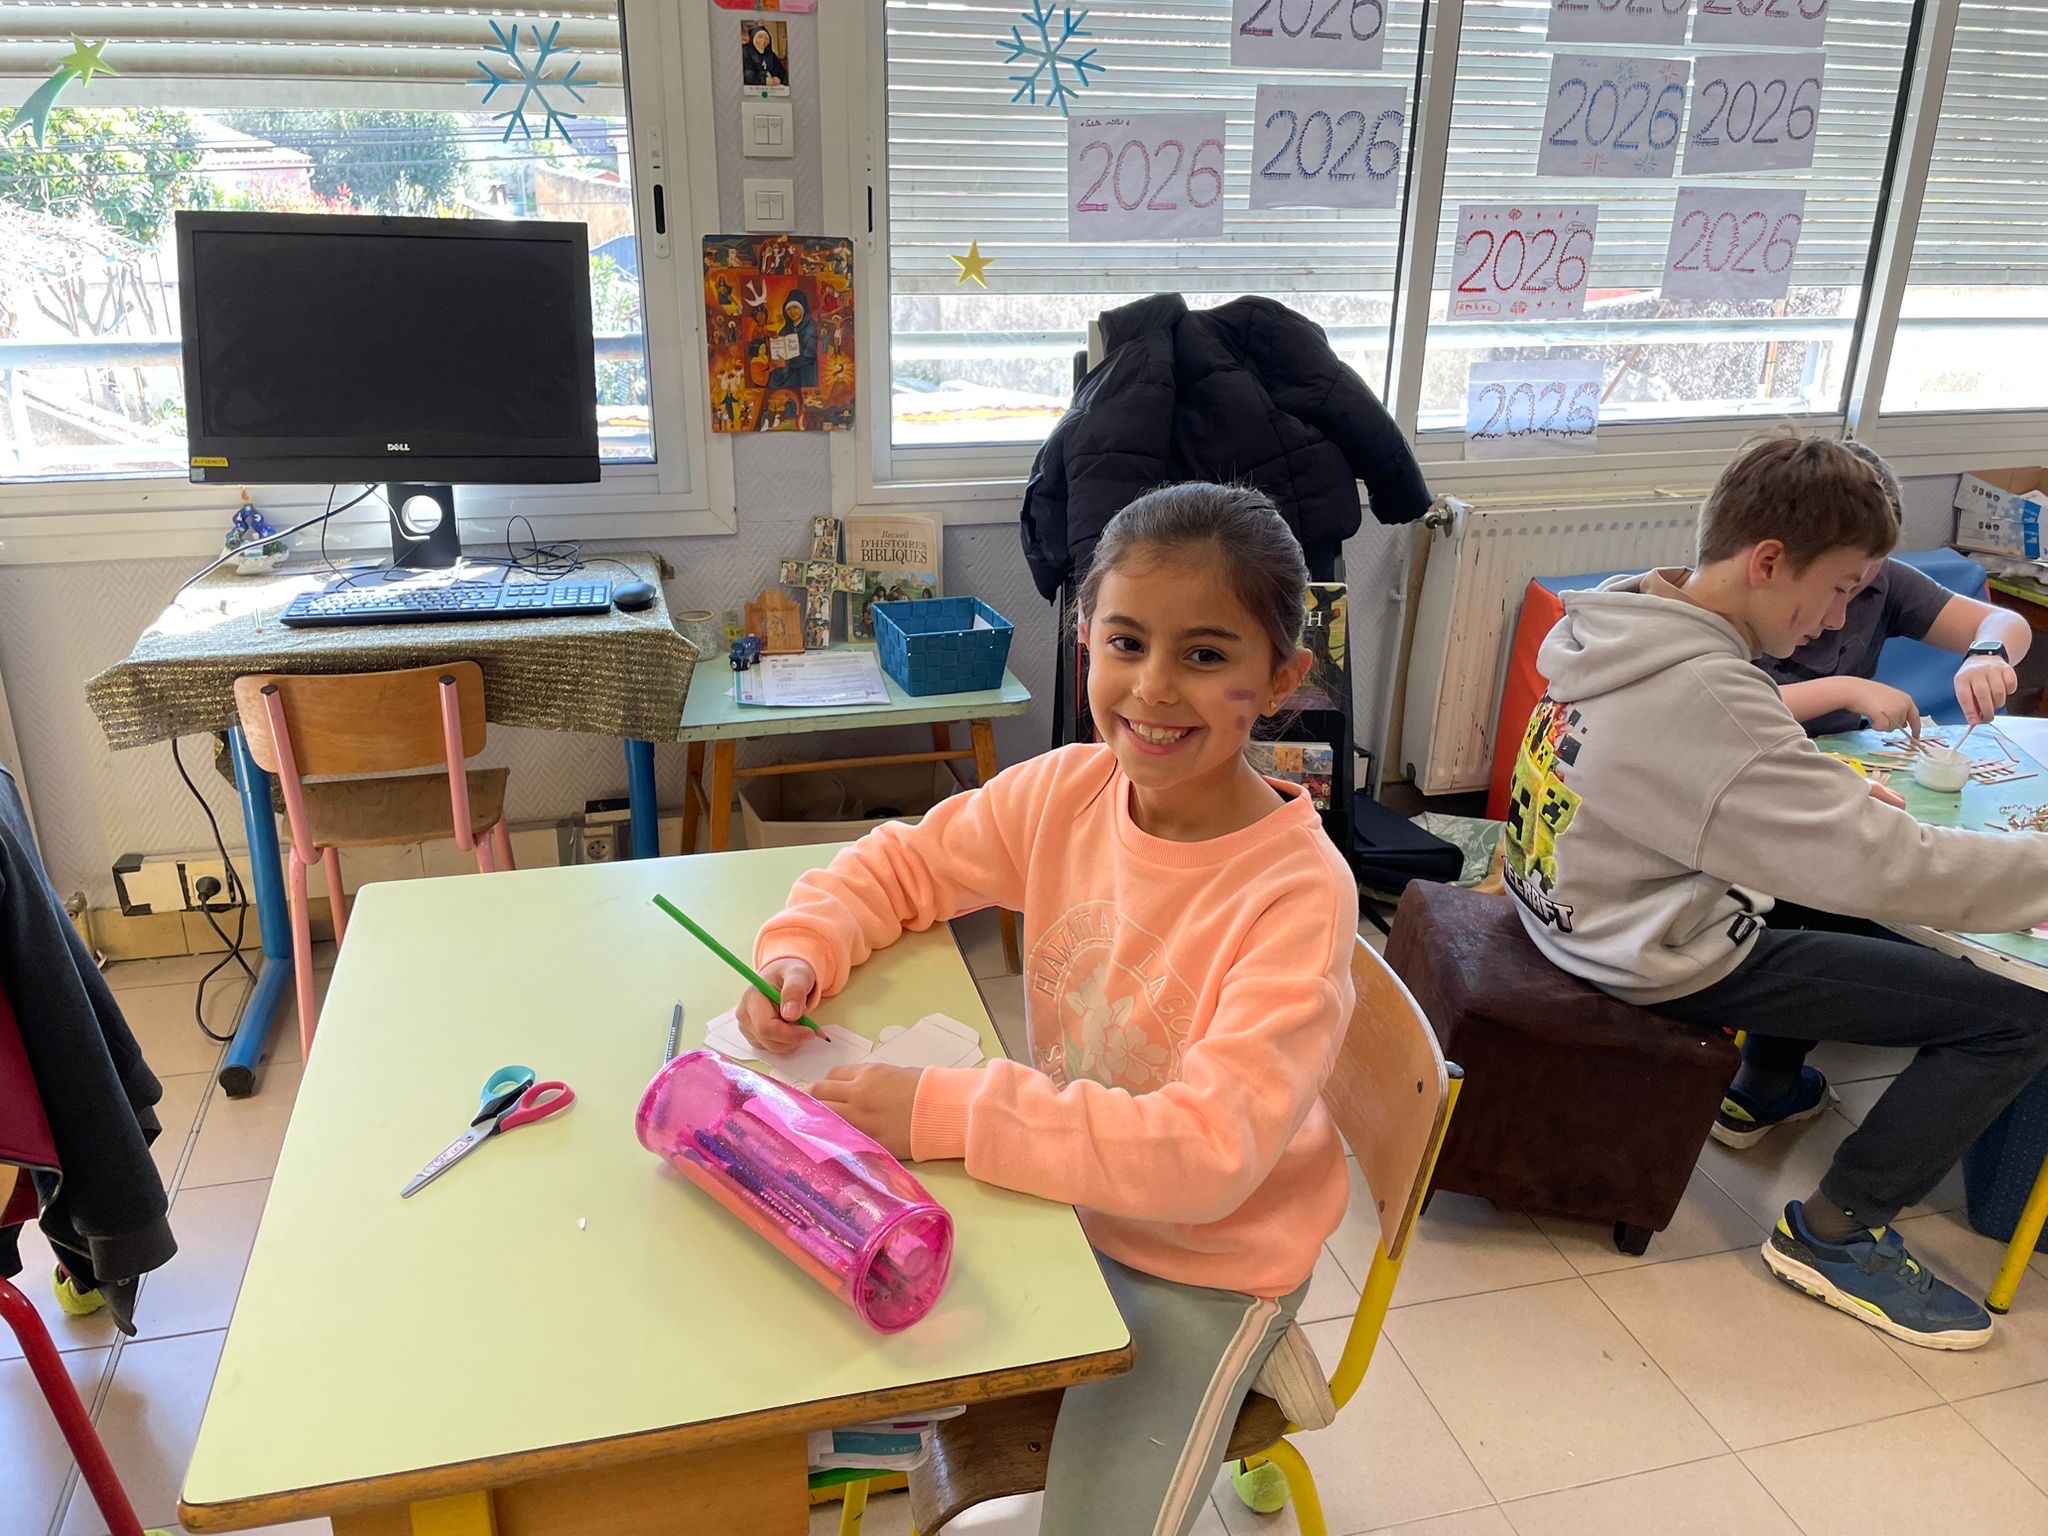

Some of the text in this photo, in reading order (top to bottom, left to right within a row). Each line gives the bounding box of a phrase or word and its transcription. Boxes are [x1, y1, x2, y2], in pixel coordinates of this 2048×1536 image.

[1549, 78, 1685, 149] 2026
[1692, 78, 1822, 146] 2026
[1077, 138, 1224, 211] 2026
[1260, 110, 1405, 181] 2026
[1458, 229, 1593, 293] 2026
[1673, 209, 1803, 274] 2026
[1471, 383, 1600, 440] 2026
[387, 443, 410, 451] DELL
[861, 539, 927, 550] D'HISTOIRES
[861, 548, 928, 565] BIBLIQUES
[881, 529, 909, 539] Recueil
[1308, 611, 1323, 626] H
[1312, 800, 1324, 810] re
[1503, 856, 1574, 933] ECRAFT
[1033, 911, 1116, 1002] HAWAIIA
